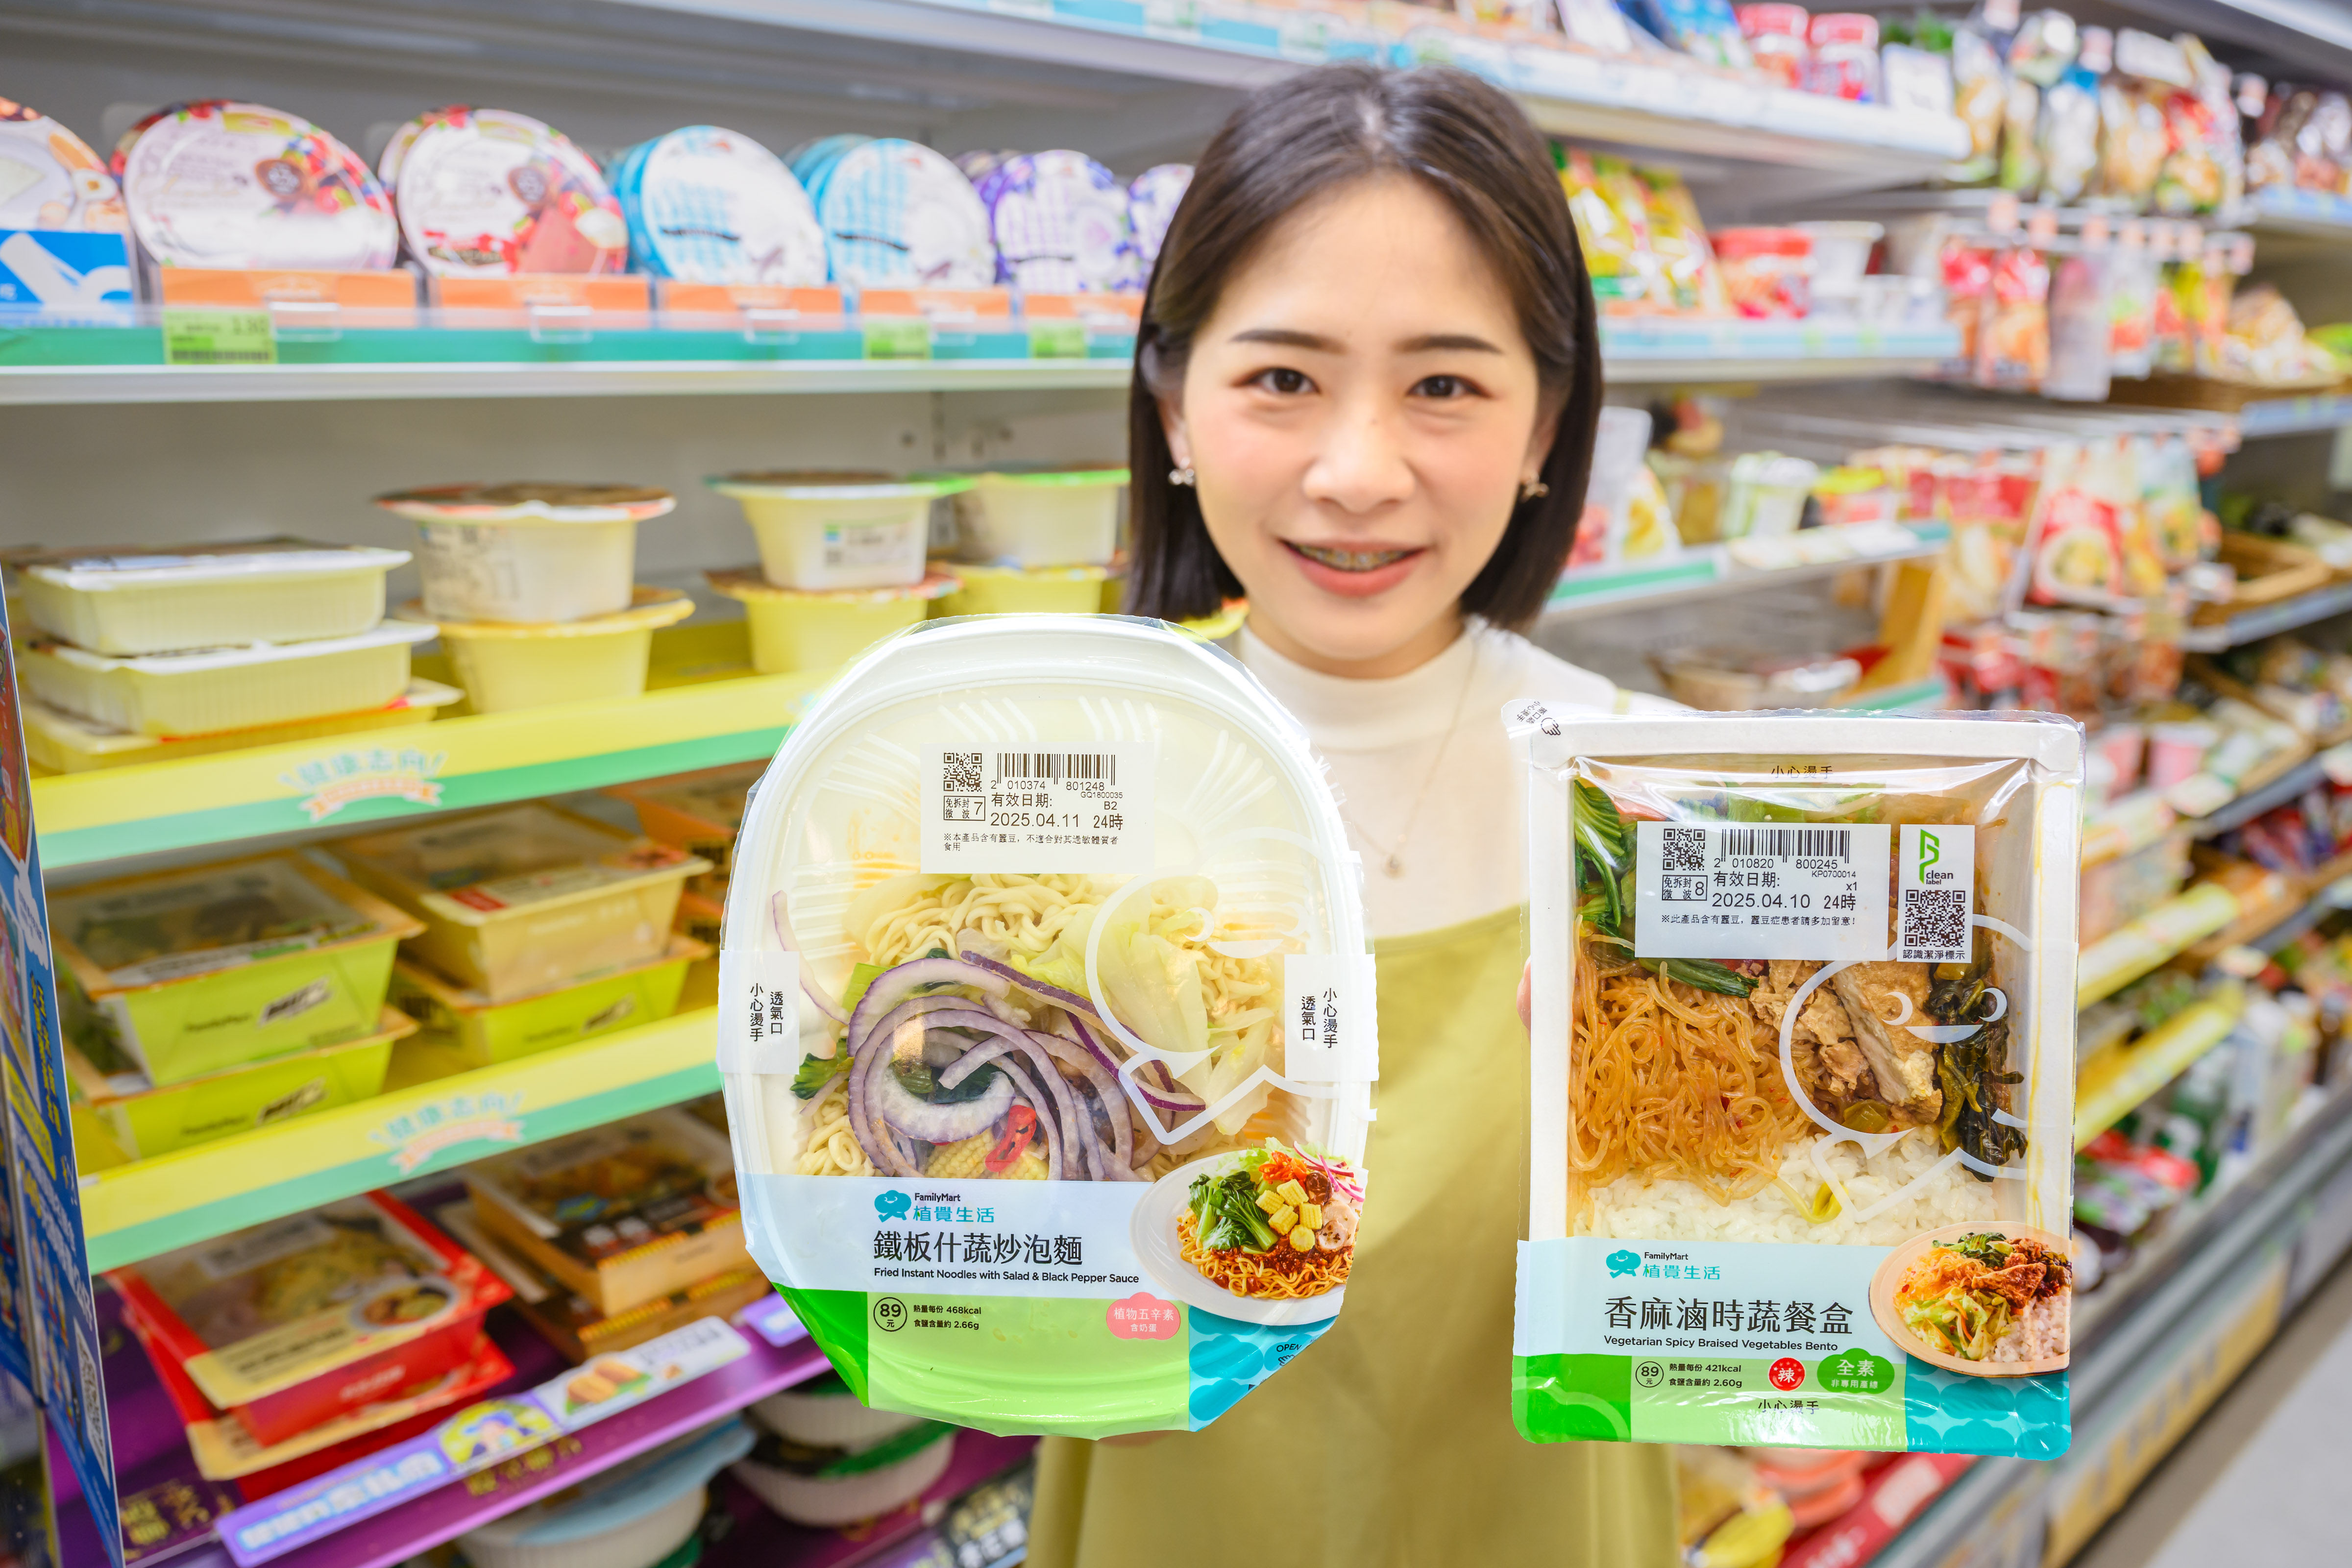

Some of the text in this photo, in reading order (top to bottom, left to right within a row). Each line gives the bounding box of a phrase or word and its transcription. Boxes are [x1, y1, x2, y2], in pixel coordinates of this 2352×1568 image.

[1771, 765, 1833, 779] 小心燙手
[991, 780, 1105, 791] 2 010374 801248
[991, 792, 1053, 808] 有效日期:
[1104, 801, 1117, 810] B2
[974, 802, 983, 815] 7
[991, 812, 1123, 830] 2025.04.11 24時
[944, 842, 960, 851] 食用
[1714, 858, 1838, 869] 2 010820 800245
[1714, 871, 1780, 887] 有效日期:
[1926, 870, 1953, 879] clean
[1695, 882, 1704, 896] 8
[1846, 882, 1857, 891] x1
[1712, 893, 1856, 911] 2025.04.10 24時
[1903, 950, 1965, 960] 認識潔淨標示
[750, 983, 763, 1042] 小心燙手
[770, 991, 784, 1034] 透氣口
[1301, 996, 1316, 1041] 透氣口
[1323, 987, 1338, 1049] 小心燙手
[915, 1192, 960, 1202] FamilyMart
[874, 1230, 1082, 1266] 鐵板什蔬炒泡麵
[1644, 1251, 1689, 1261] FamilyMart
[874, 1268, 899, 1277] Fried
[902, 1269, 934, 1278] Instant
[937, 1270, 977, 1279] Noodles
[980, 1271, 1000, 1279] with
[1004, 1271, 1029, 1280] Salad
[1042, 1272, 1068, 1281] Black
[1072, 1274, 1106, 1284] Pepper
[1109, 1274, 1139, 1283] Sauce
[880, 1303, 901, 1318] 89
[913, 1305, 981, 1315] 熱量每份 468kcal
[1114, 1308, 1174, 1321] 植物五辛素
[1604, 1296, 1853, 1335] 香麻滷時蔬餐盒
[914, 1320, 979, 1330] 食鹽含量約 2.66g
[1130, 1323, 1156, 1332] 含奶蛋
[1276, 1344, 1301, 1352] OPEN
[1604, 1335, 1838, 1351] Vegetarian Spicy Braised Vegetables Bento
[1641, 1366, 1659, 1377] 89
[1669, 1363, 1741, 1373] 熱量每份 421kcal
[1837, 1359, 1875, 1377] 全素
[1778, 1368, 1795, 1383] 辣
[1669, 1378, 1742, 1389] 食鹽含量約 2.60g
[1831, 1379, 1878, 1389] 非專用產線
[1758, 1399, 1819, 1415] 小心燙手
